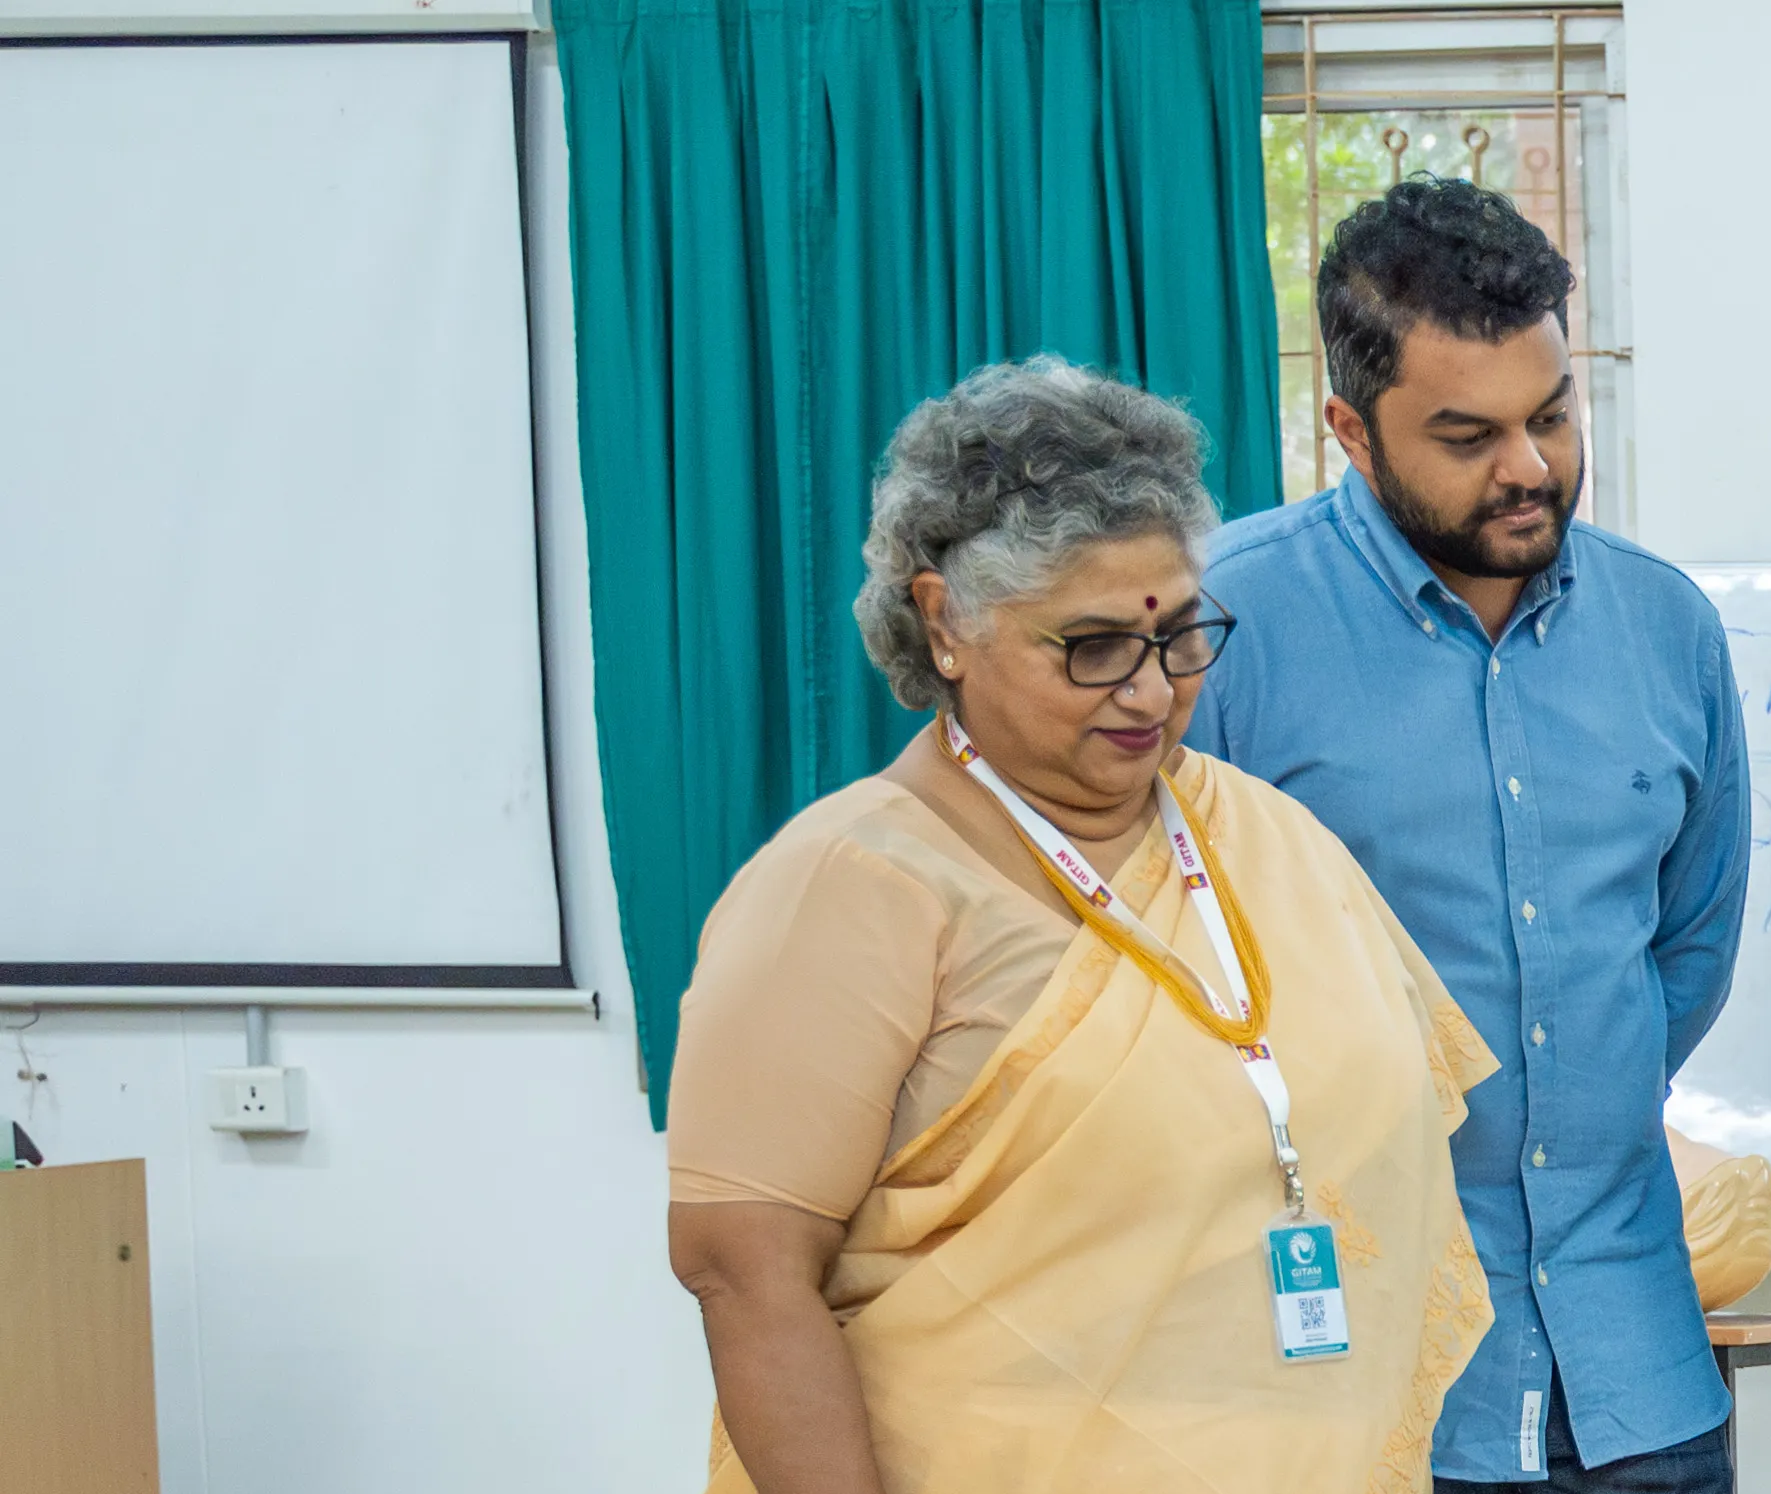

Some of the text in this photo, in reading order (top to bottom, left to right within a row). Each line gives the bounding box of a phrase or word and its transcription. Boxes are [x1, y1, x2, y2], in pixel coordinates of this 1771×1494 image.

[1055, 849, 1091, 887] GITAM
[1172, 831, 1195, 868] GITAM
[1290, 1266, 1323, 1278] GITAM
